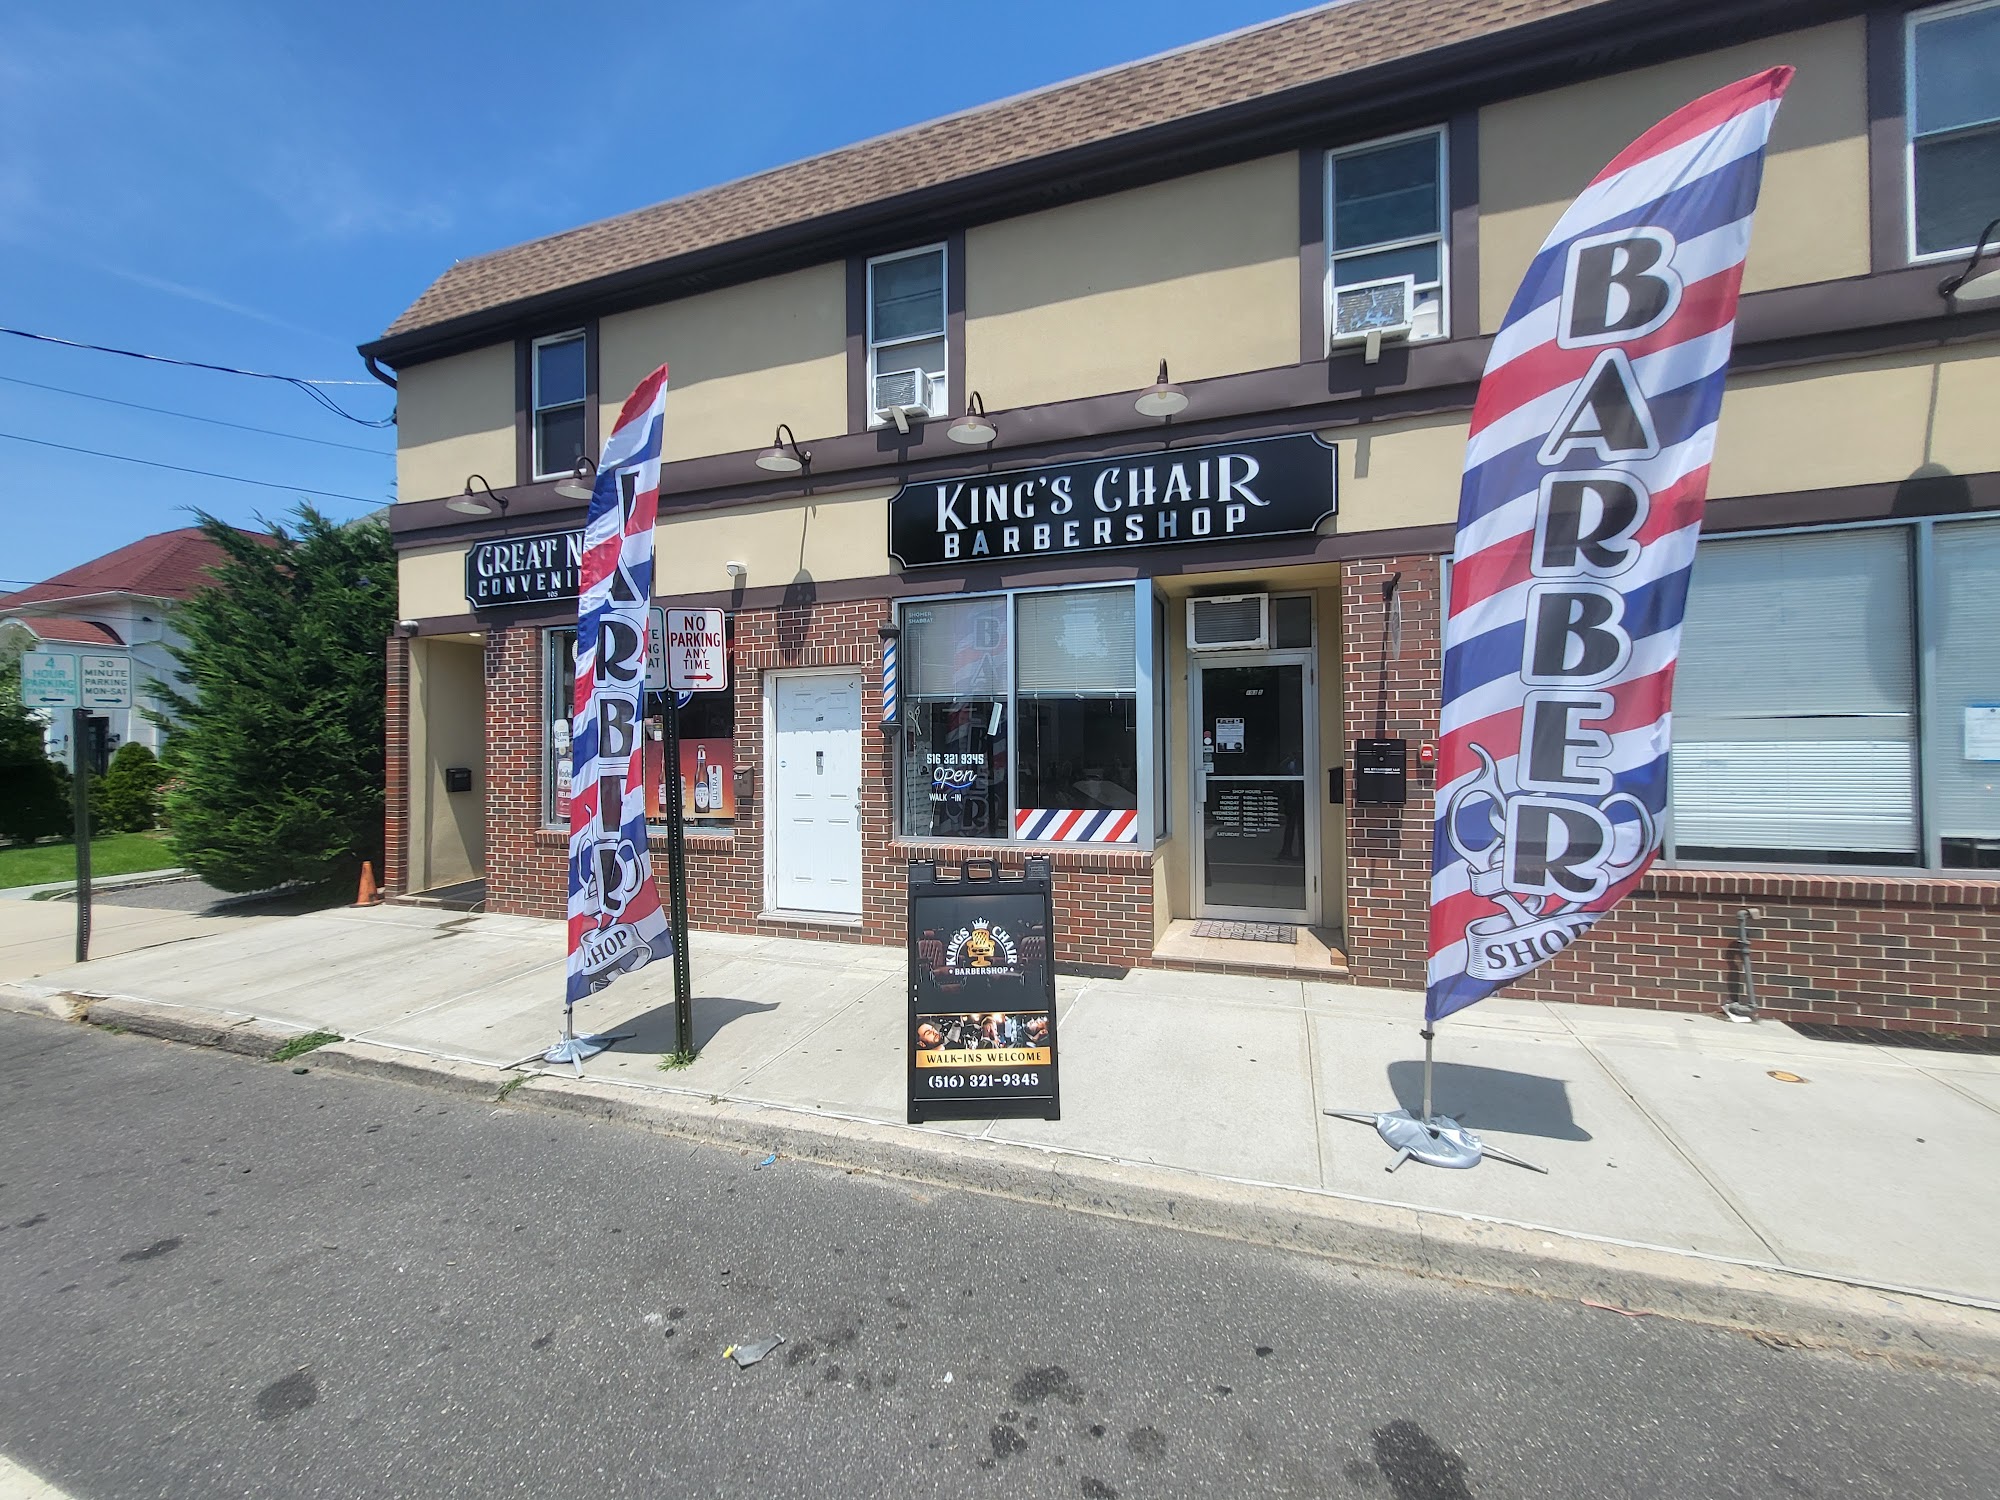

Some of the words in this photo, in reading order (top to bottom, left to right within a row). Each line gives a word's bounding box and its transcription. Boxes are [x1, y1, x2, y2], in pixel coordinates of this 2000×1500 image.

[936, 476, 1073, 533] KING'S
[1093, 453, 1271, 513] CHAIR
[943, 502, 1247, 559] BARBERSHOP
[477, 539, 558, 578] GREAT
[1503, 227, 1684, 901] BARBER
[684, 616, 706, 631] NO
[670, 632, 721, 648] PARKING
[685, 648, 707, 659] ANY
[45, 656, 55, 668] 4
[98, 660, 114, 668] 30
[683, 659, 711, 670] TIME
[32, 669, 66, 678] HOUR
[84, 669, 128, 677] MINUTE
[25, 679, 75, 688] PARKING
[85, 678, 127, 686] PARKING
[926, 753, 941, 765] 516
[943, 753, 958, 765] 321
[961, 753, 985, 765] 9345
[933, 766, 977, 789] Open
[928, 793, 948, 802] WALK
[945, 926, 970, 966] KINGS
[992, 925, 1018, 964] CHAIR
[954, 966, 1009, 976] BARBERSHOP
[926, 1053, 982, 1064] WALK-INS
[987, 1052, 1042, 1062] WELCOME
[928, 1074, 965, 1089] (516)
[969, 1073, 1039, 1088] 321-9345
